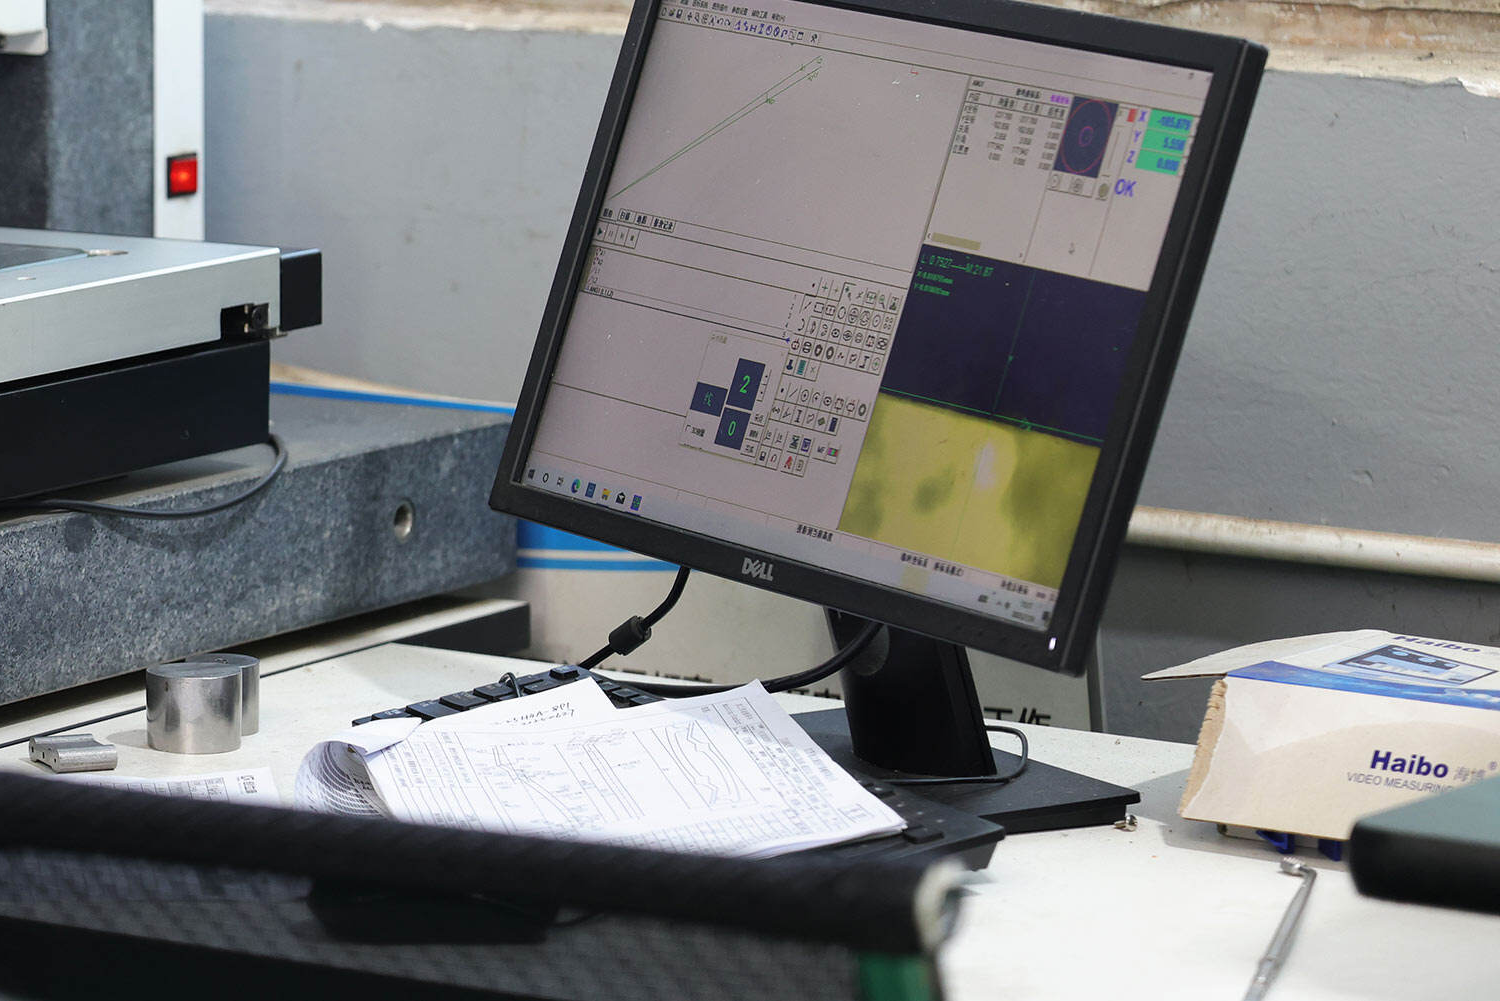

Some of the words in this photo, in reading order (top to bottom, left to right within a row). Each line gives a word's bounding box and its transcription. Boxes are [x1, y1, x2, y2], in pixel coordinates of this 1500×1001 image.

[1138, 109, 1148, 123] X
[1133, 130, 1141, 143] Y
[1126, 150, 1135, 164] Z
[1114, 179, 1137, 198] OK
[739, 375, 750, 394] 2
[728, 420, 737, 437] 0
[741, 557, 774, 582] DELL
[1392, 635, 1482, 653] Haibo
[1369, 749, 1449, 779] Haibo
[1346, 772, 1383, 786] VIDEO
